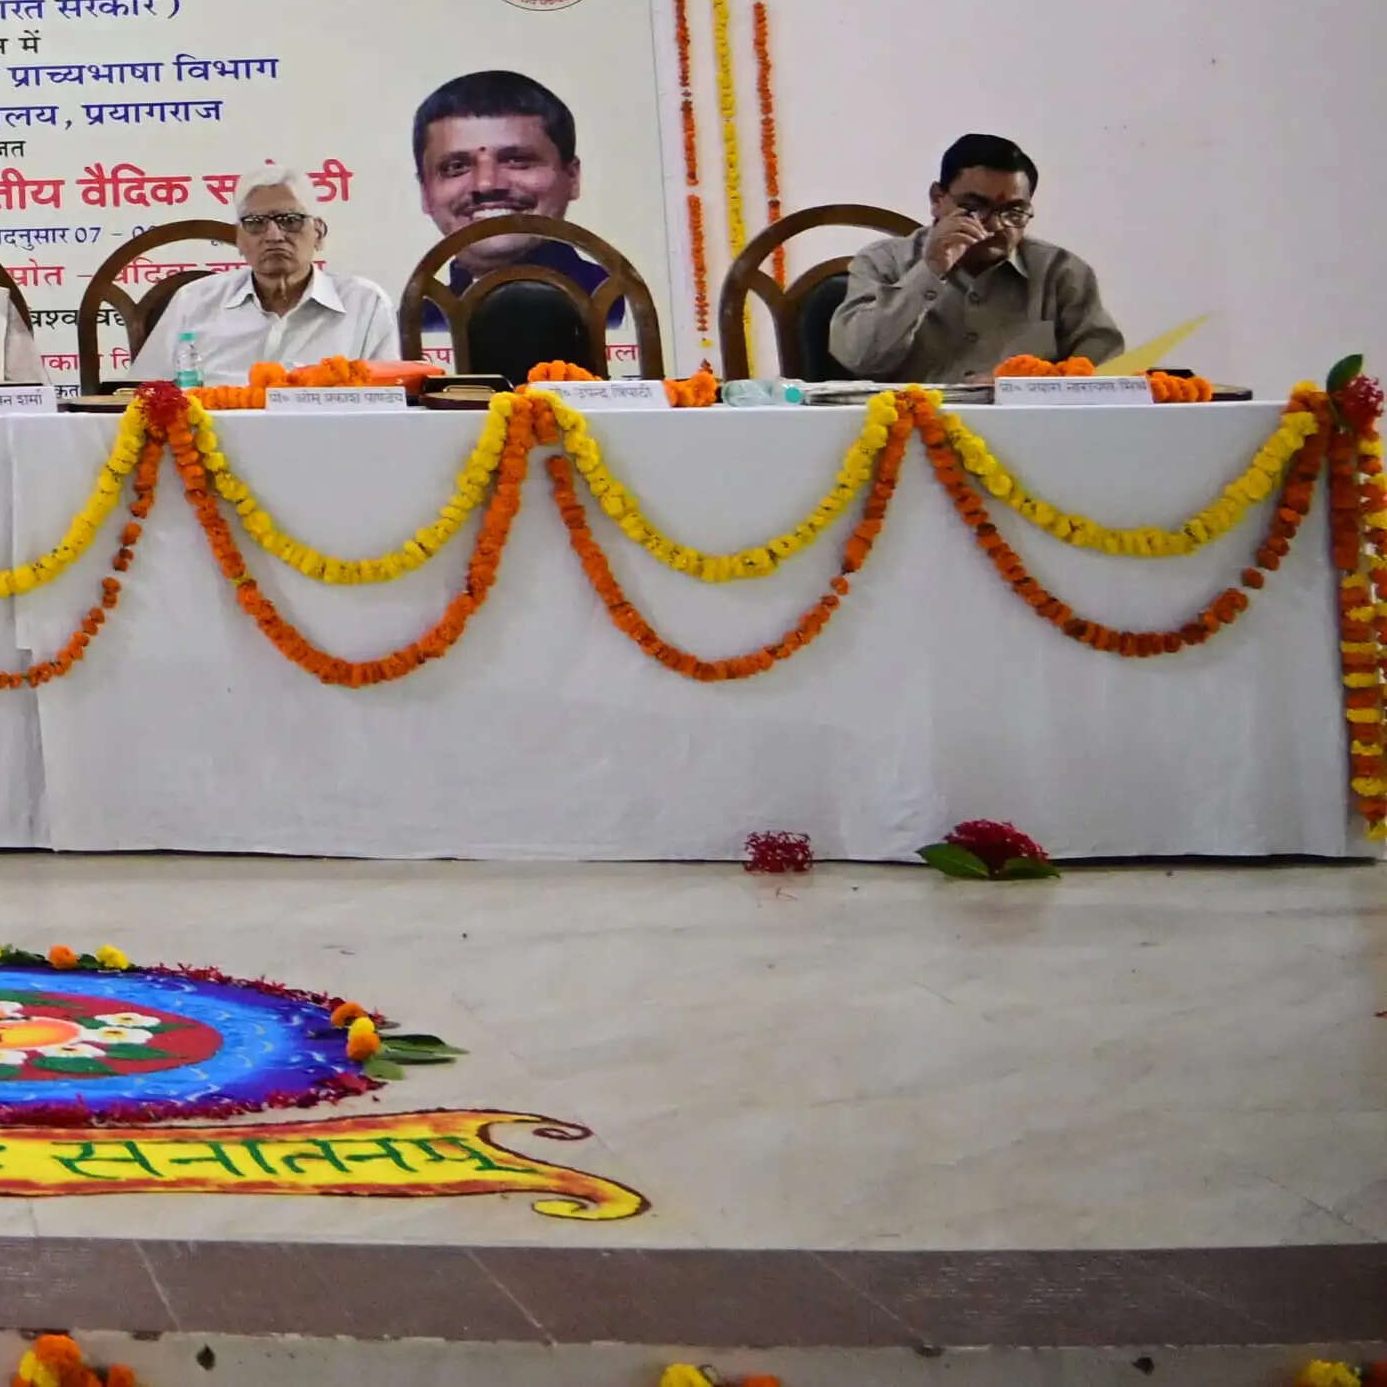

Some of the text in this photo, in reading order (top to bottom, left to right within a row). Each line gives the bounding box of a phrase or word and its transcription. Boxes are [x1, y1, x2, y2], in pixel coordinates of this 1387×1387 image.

[18, 29, 41, 54] में
[7, 60, 164, 89] प्राच्यभाषा
[172, 52, 280, 82] विभाग
[81, 99, 224, 126] प्रयागराज
[76, 162, 193, 209] वैदिक
[74, 227, 102, 244] 07
